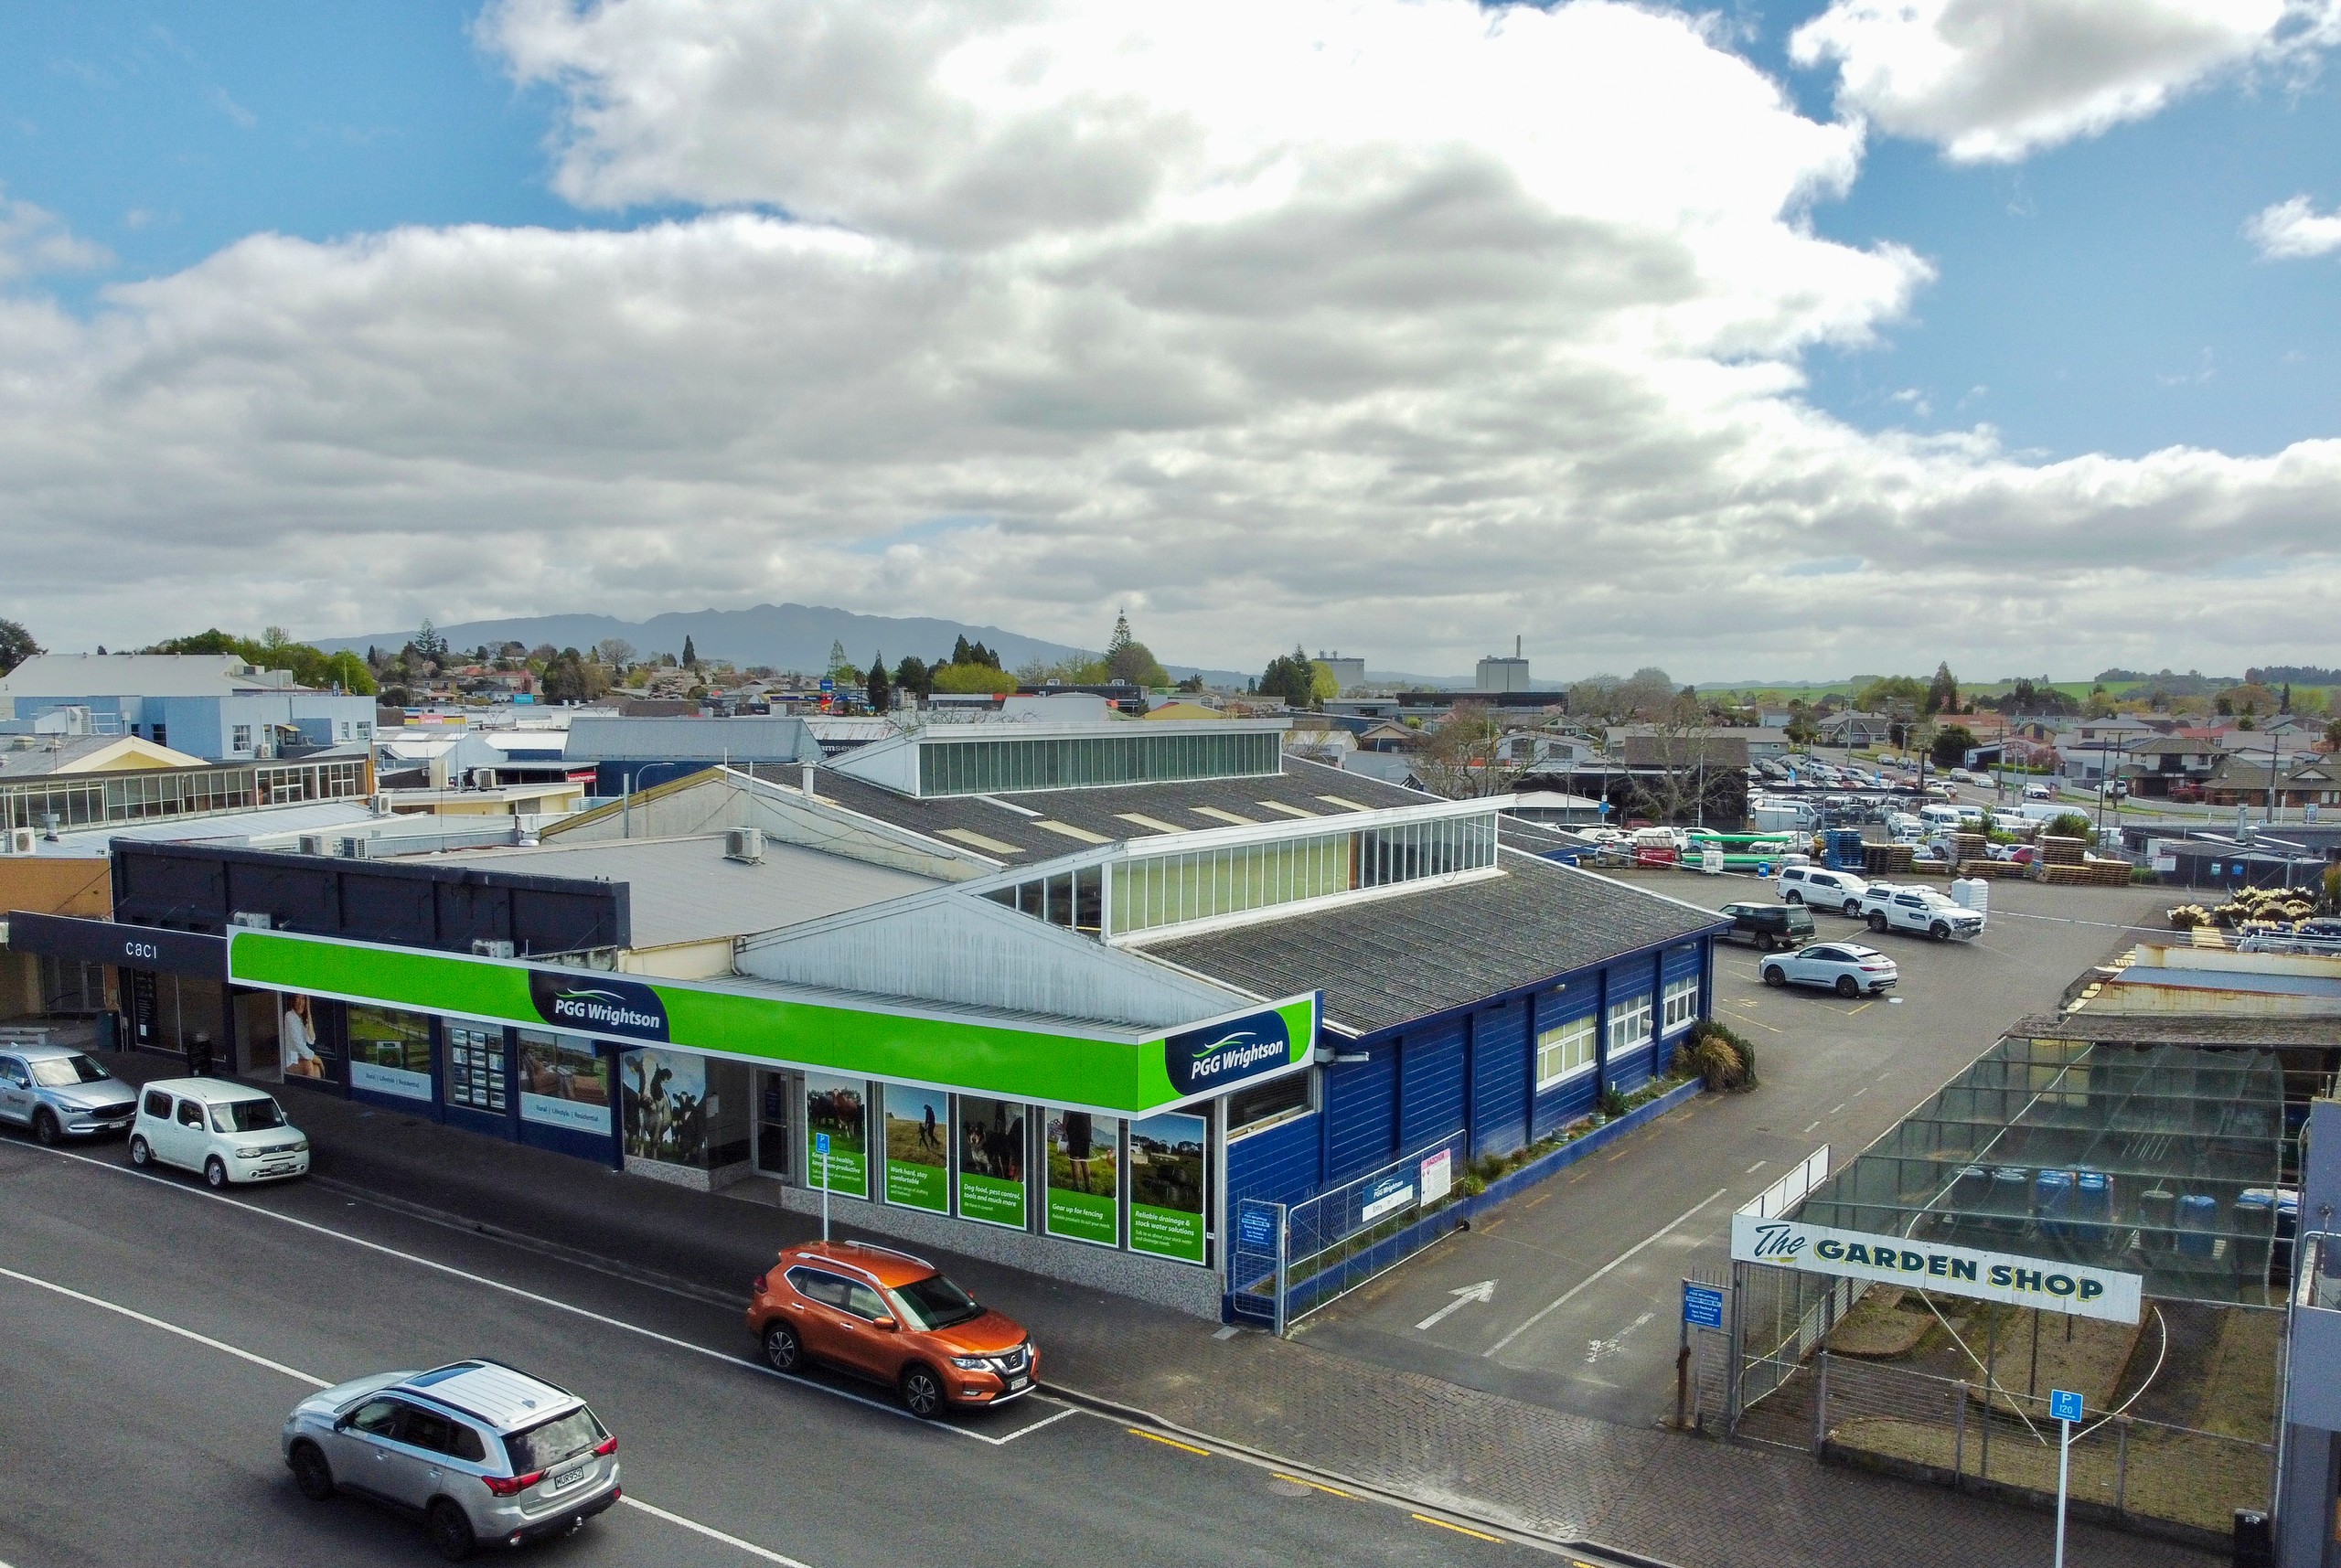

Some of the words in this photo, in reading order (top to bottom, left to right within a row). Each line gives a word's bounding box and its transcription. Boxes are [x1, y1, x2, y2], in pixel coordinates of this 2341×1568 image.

[555, 999, 585, 1017] PGG
[588, 1003, 659, 1028] Wrightson
[1191, 1055, 1221, 1079] PGG
[1223, 1040, 1283, 1069] Wrightson
[964, 1183, 975, 1192] Dog
[1384, 1180, 1404, 1194] Wrightson
[1052, 1203, 1065, 1211] Gear
[1083, 1208, 1104, 1220] fencing
[1135, 1211, 1159, 1221] Reliable
[1159, 1214, 1185, 1226] drainage
[1135, 1220, 1150, 1228] stock
[1150, 1222, 1168, 1231] water
[1168, 1226, 1194, 1236] solutions
[1756, 1224, 1808, 1257] The
[1814, 1239, 1977, 1281] GARDEN
[1988, 1264, 2104, 1302] SHOP
[2062, 1392, 2072, 1403] P
[2059, 1404, 2073, 1414] 120
